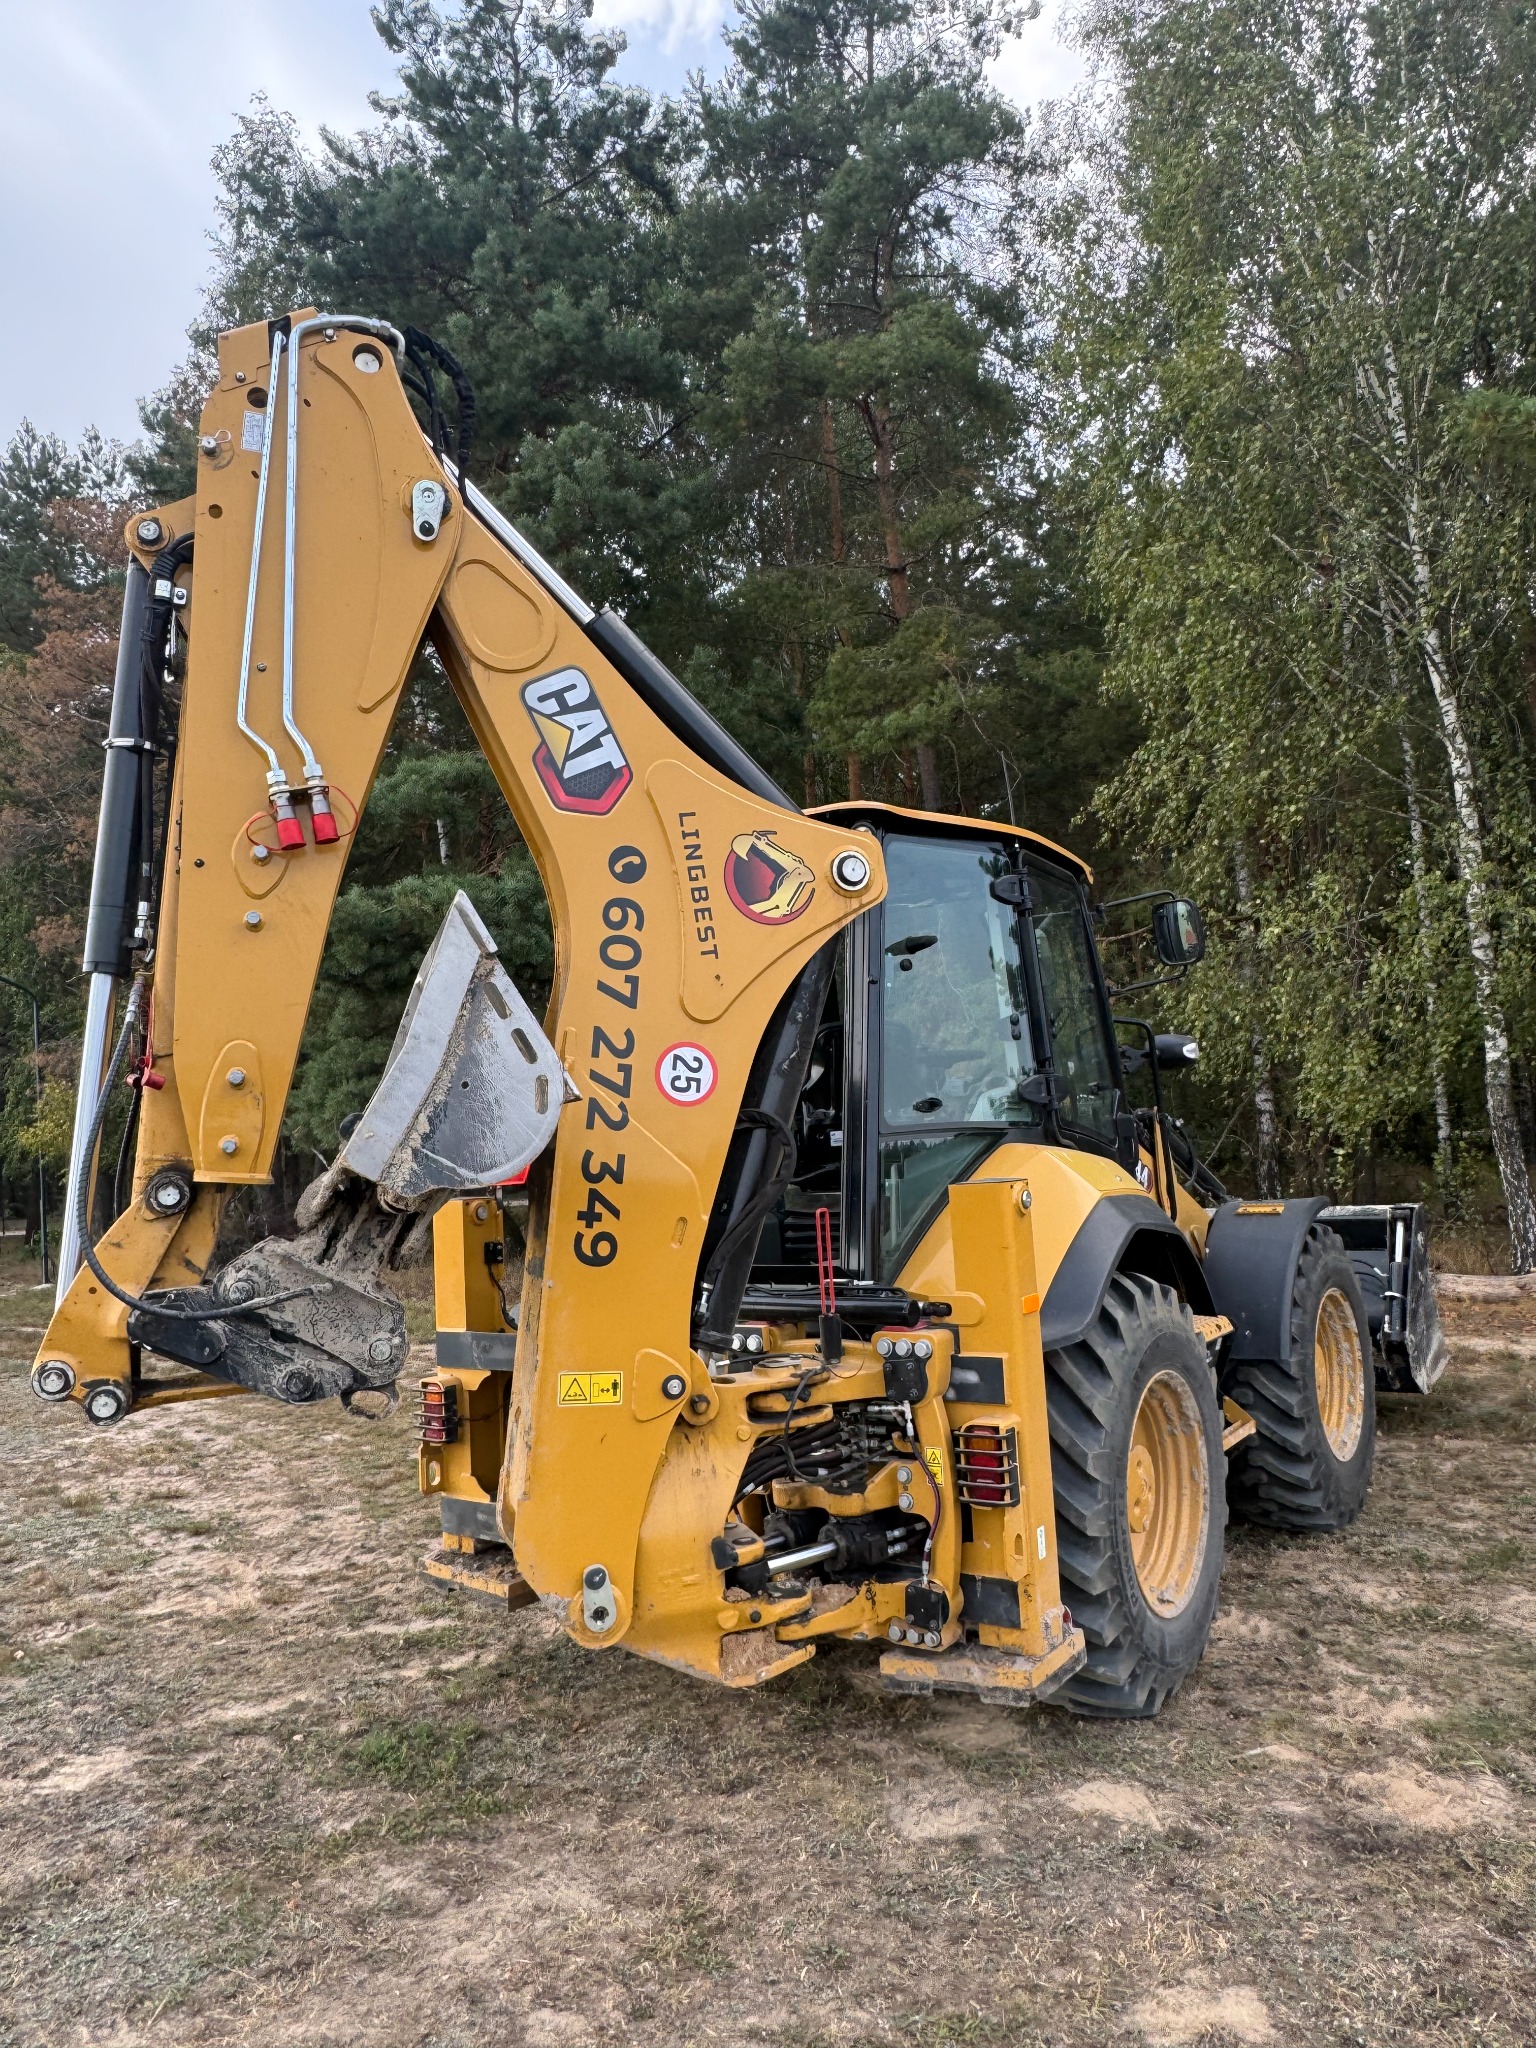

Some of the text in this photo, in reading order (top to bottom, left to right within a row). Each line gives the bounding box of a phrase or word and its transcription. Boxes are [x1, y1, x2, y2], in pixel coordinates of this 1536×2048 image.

[524, 668, 627, 779] CAT
[678, 811, 719, 960] LINGBEST
[573, 897, 645, 1268] 607 272 349
[670, 1053, 703, 1093] 25
